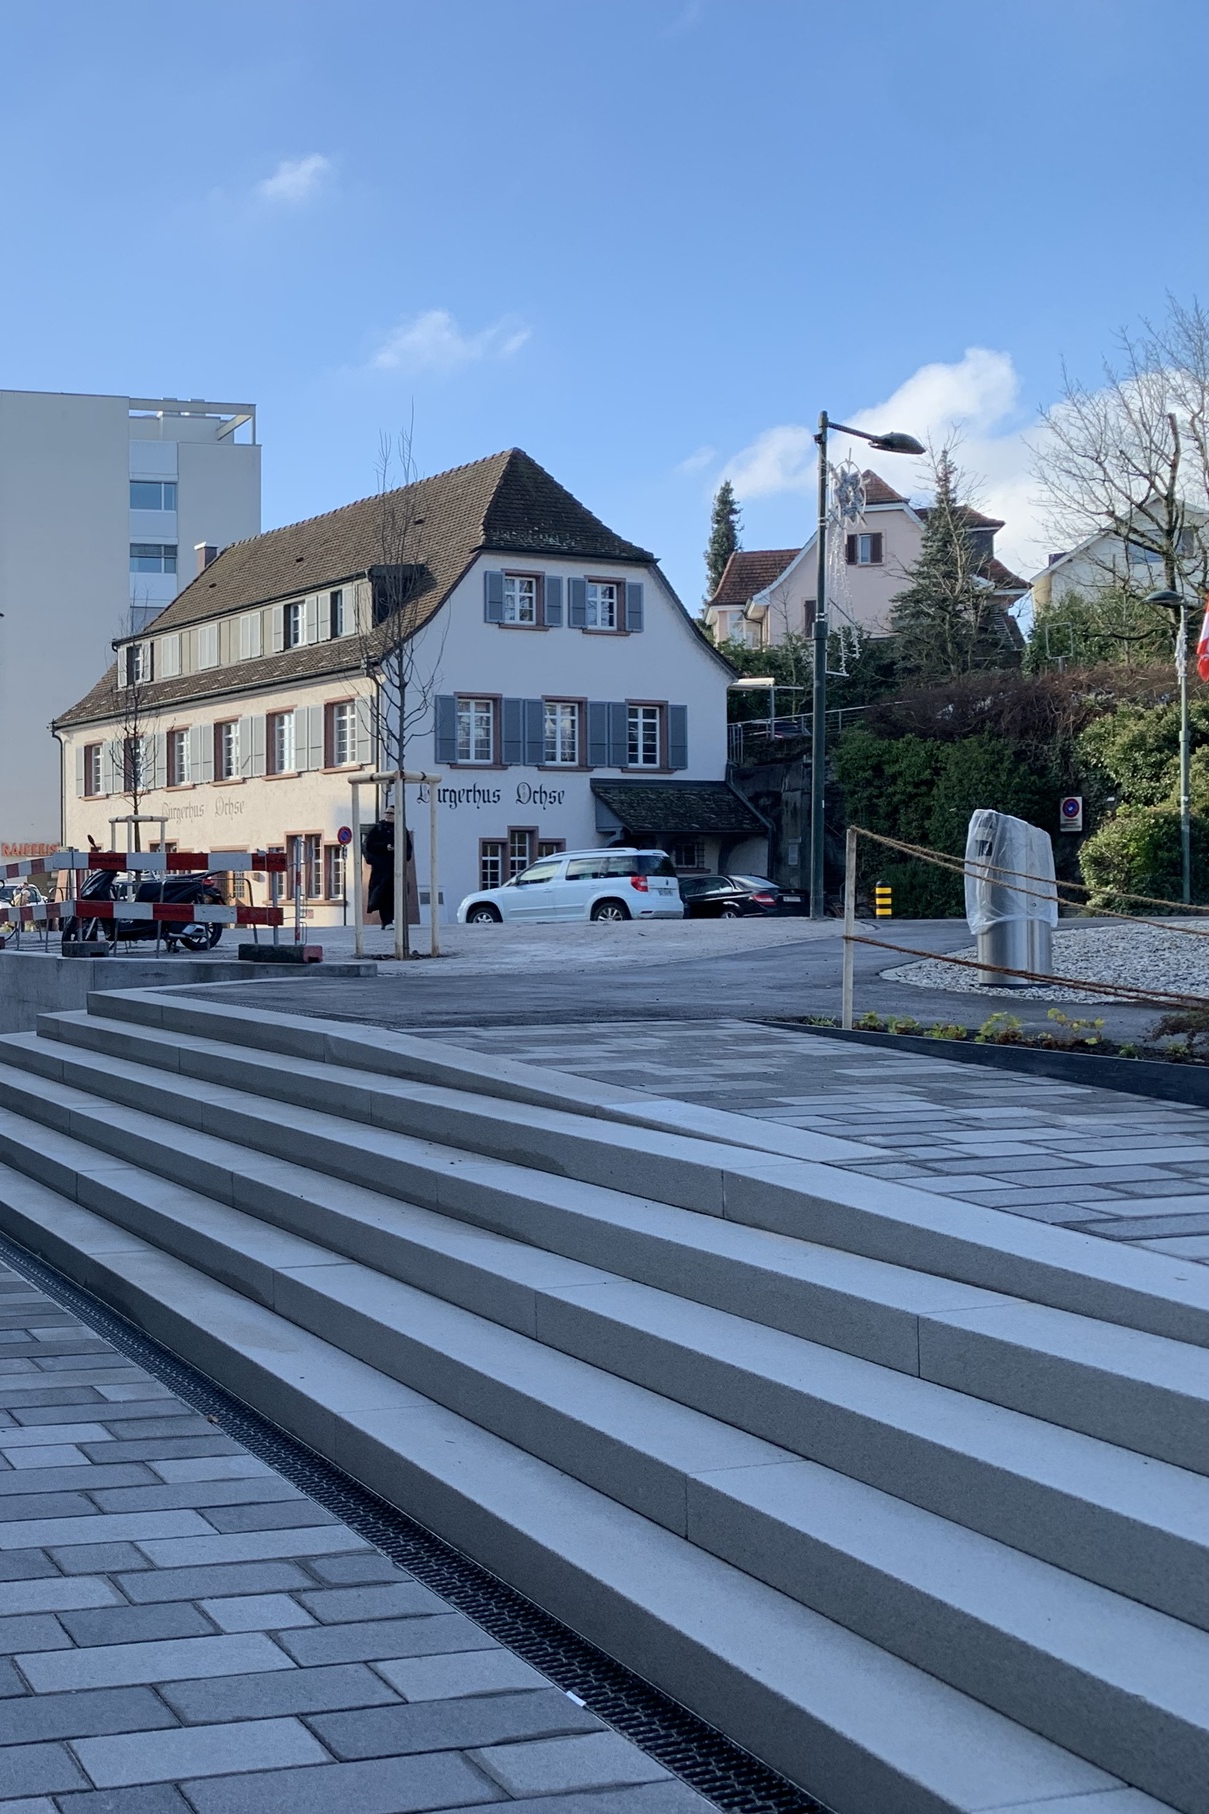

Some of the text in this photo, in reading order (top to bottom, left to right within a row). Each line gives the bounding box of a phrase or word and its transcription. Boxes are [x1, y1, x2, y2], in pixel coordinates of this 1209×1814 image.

[215, 796, 245, 820] Ochse
[516, 782, 565, 810] Ochse
[1, 842, 60, 857] RAIFFEIS
